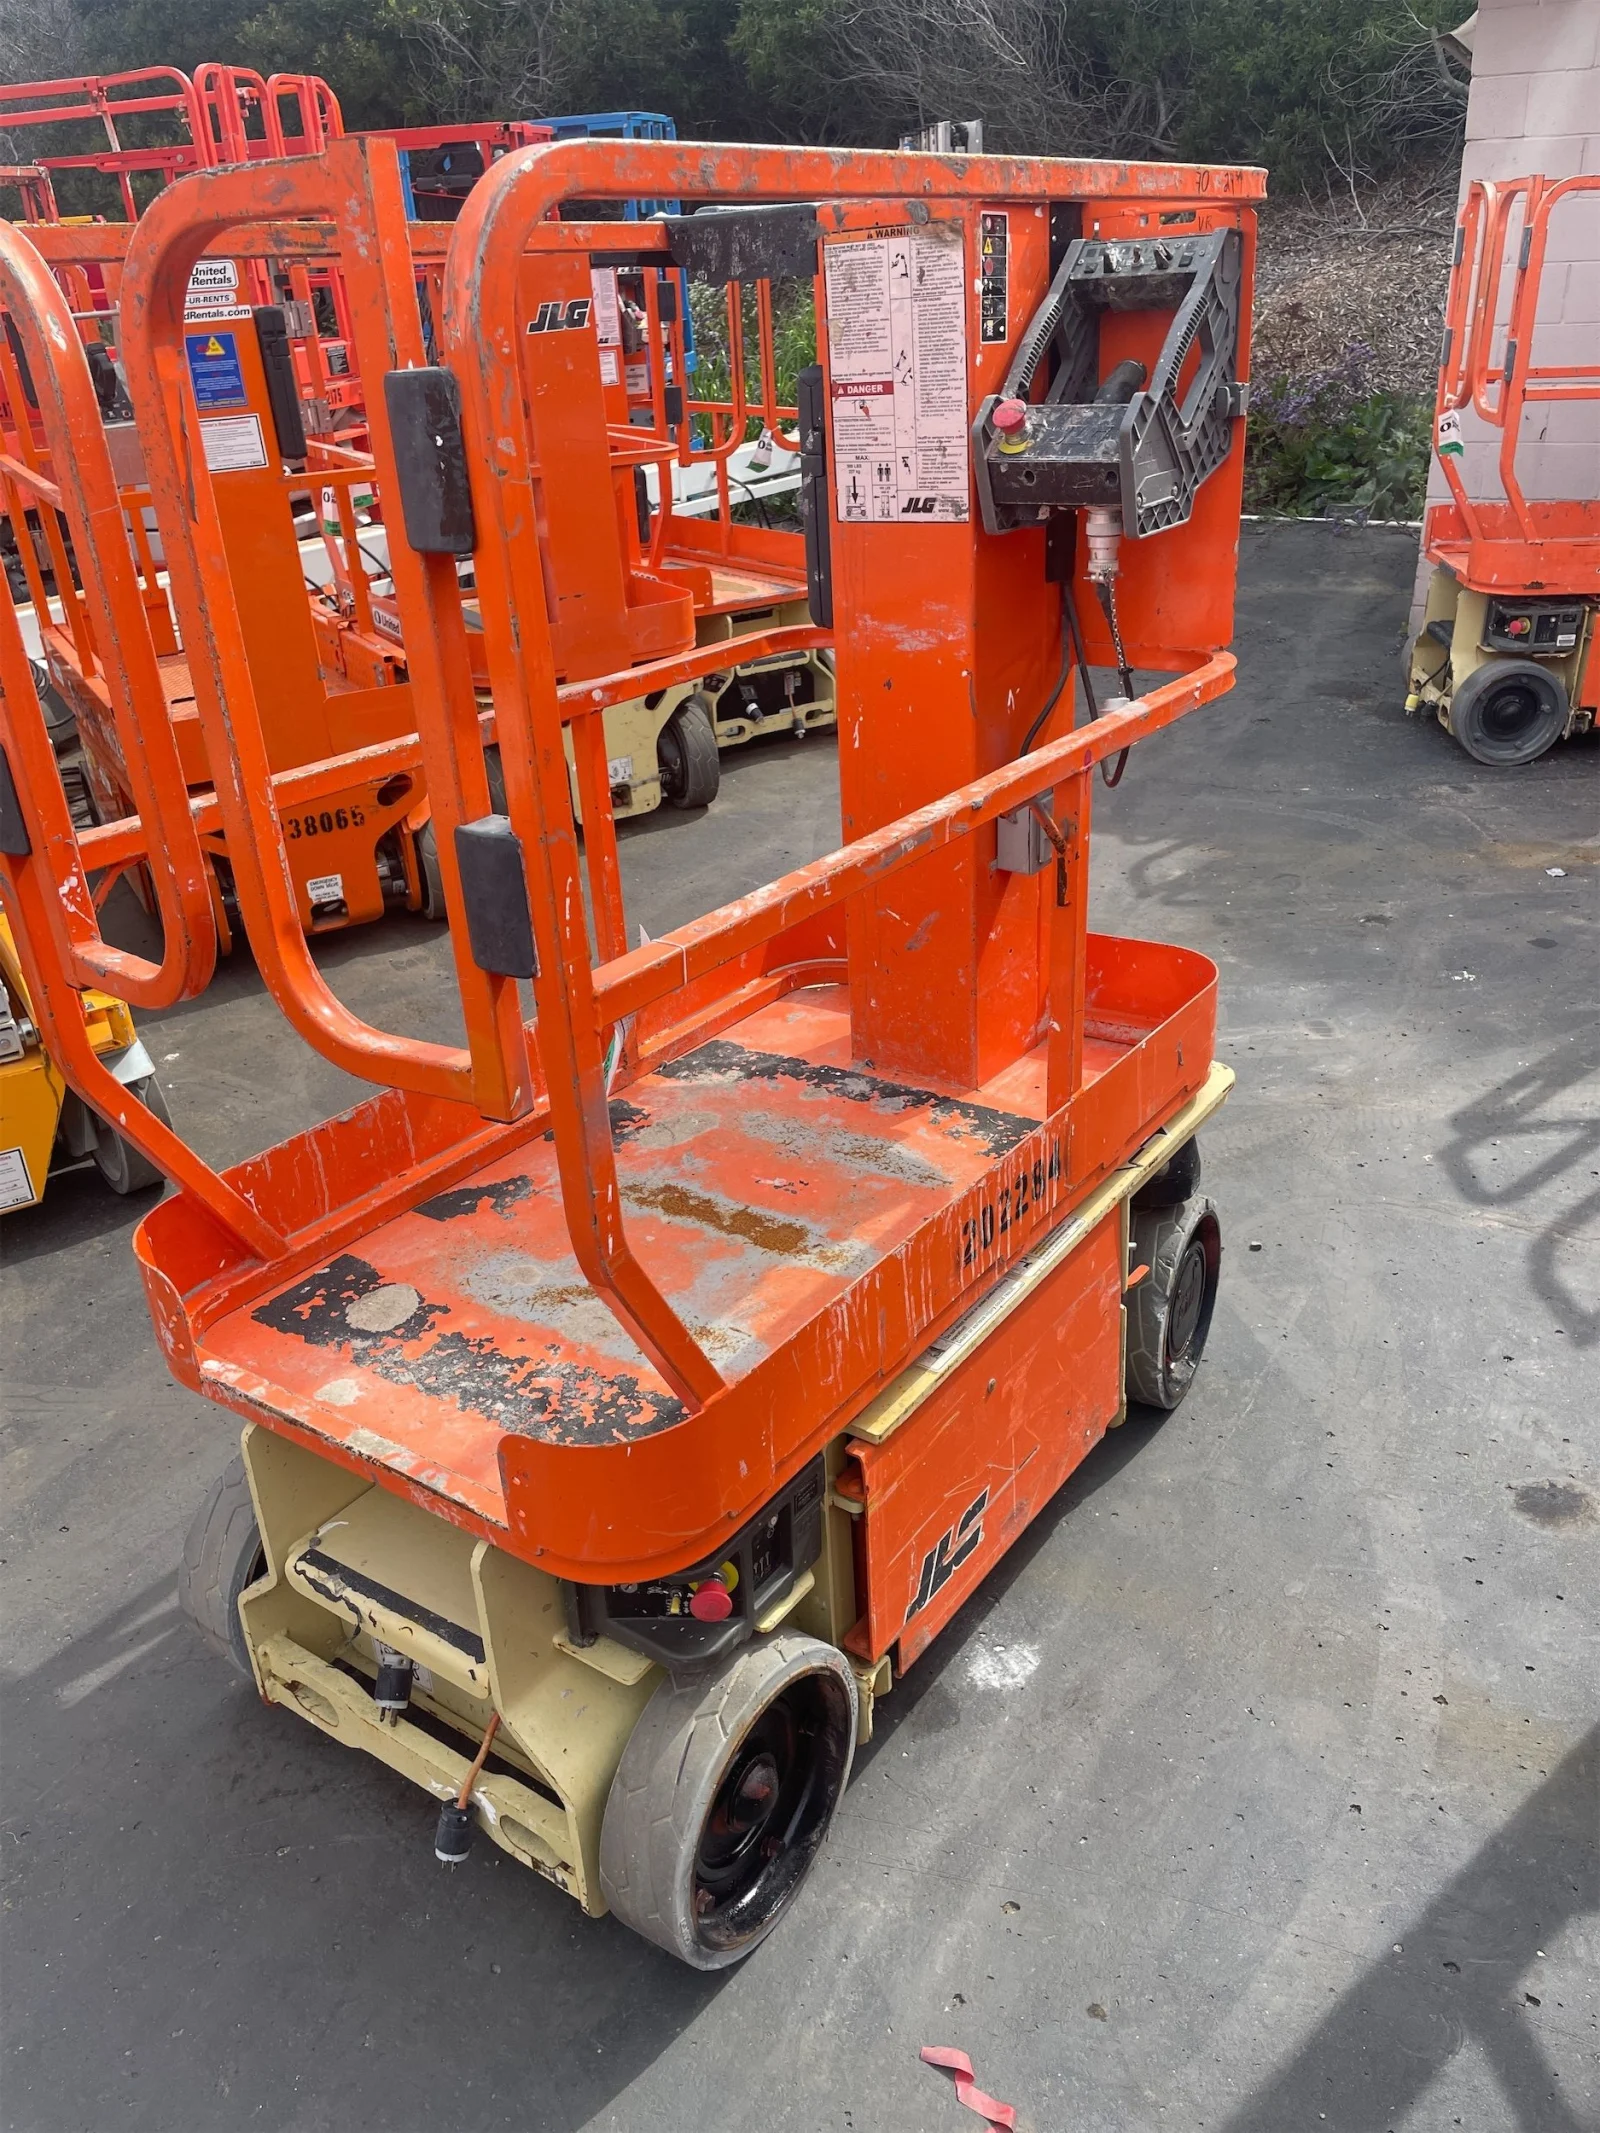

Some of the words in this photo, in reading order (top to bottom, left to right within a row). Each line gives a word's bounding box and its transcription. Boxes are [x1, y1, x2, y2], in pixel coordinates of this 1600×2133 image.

[876, 226, 920, 238] WARNING
[192, 275, 232, 285] Rentals
[528, 299, 592, 334] JLG
[848, 384, 883, 394] DANGER
[901, 497, 937, 513] JLG
[382, 614, 400, 634] United
[963, 1138, 1061, 1268] 202284
[904, 1485, 989, 1625] JLG
